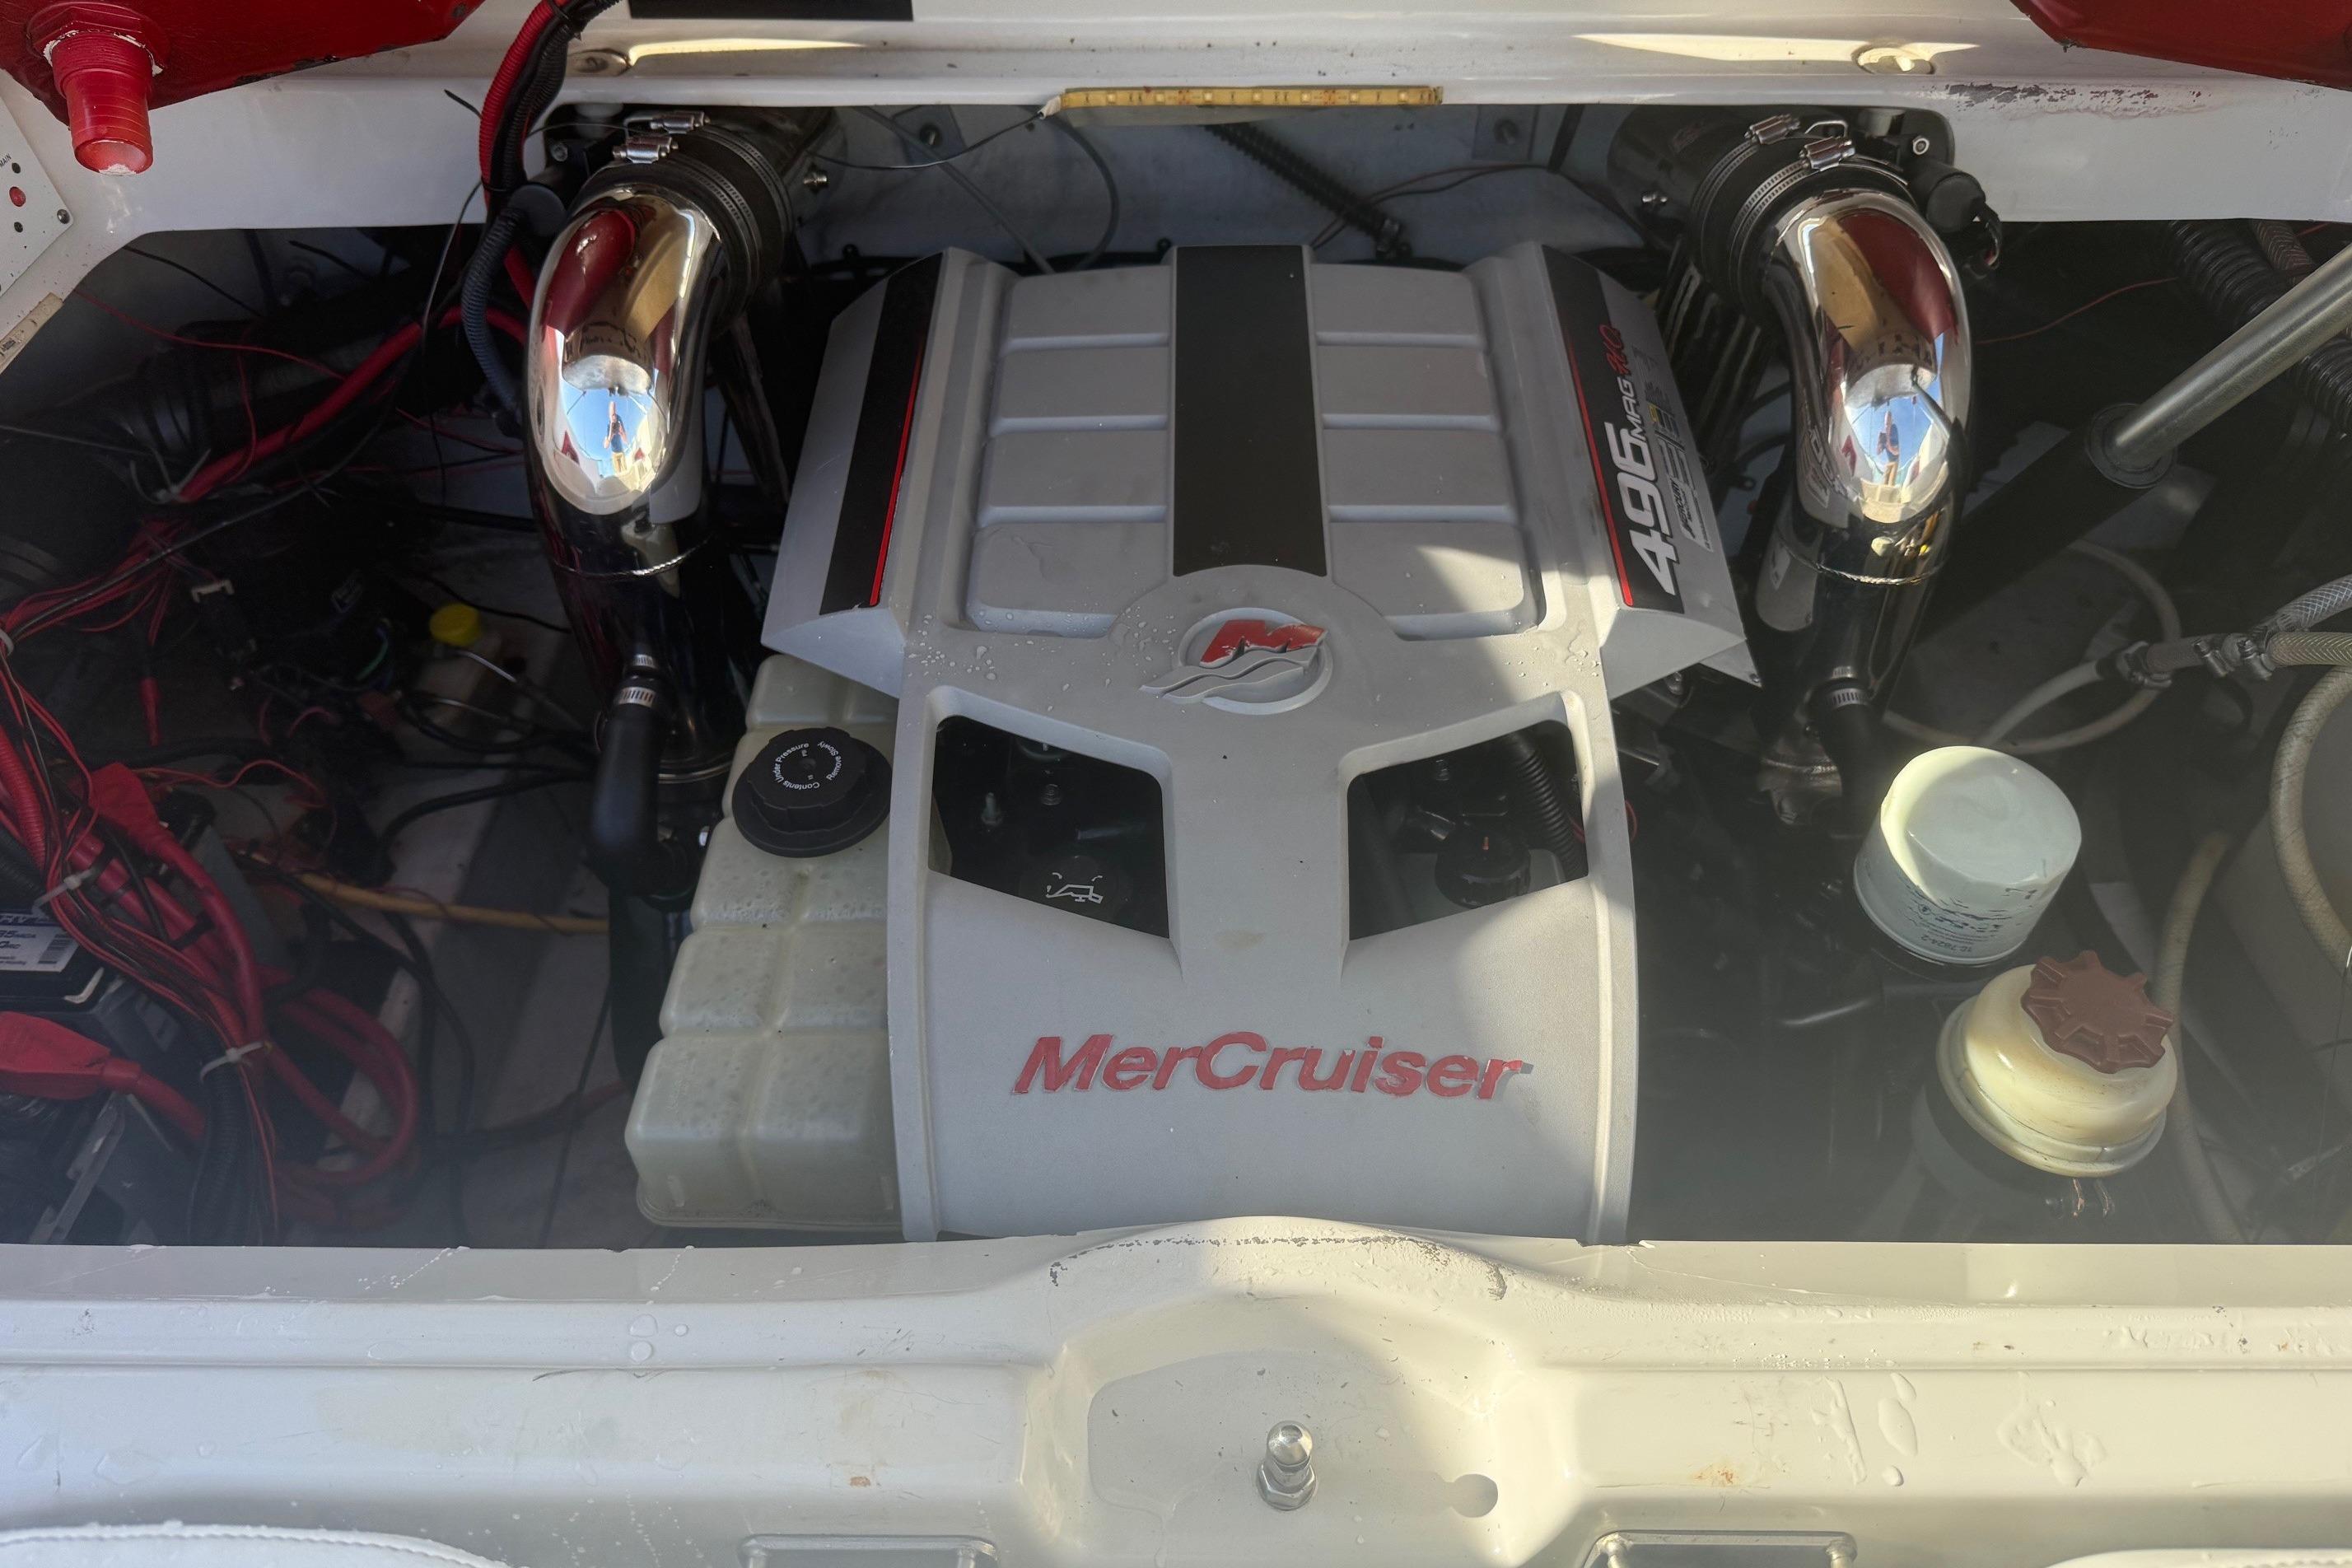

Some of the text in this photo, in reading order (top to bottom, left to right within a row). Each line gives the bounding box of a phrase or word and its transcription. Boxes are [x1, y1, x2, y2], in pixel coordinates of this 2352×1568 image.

[1617, 376, 1648, 441] MAG
[1604, 422, 1678, 595] 496
[772, 743, 820, 790] Contents Under Pressure
[818, 741, 842, 781] Remove Slowly
[1012, 1031, 1533, 1099] MerCruiser
